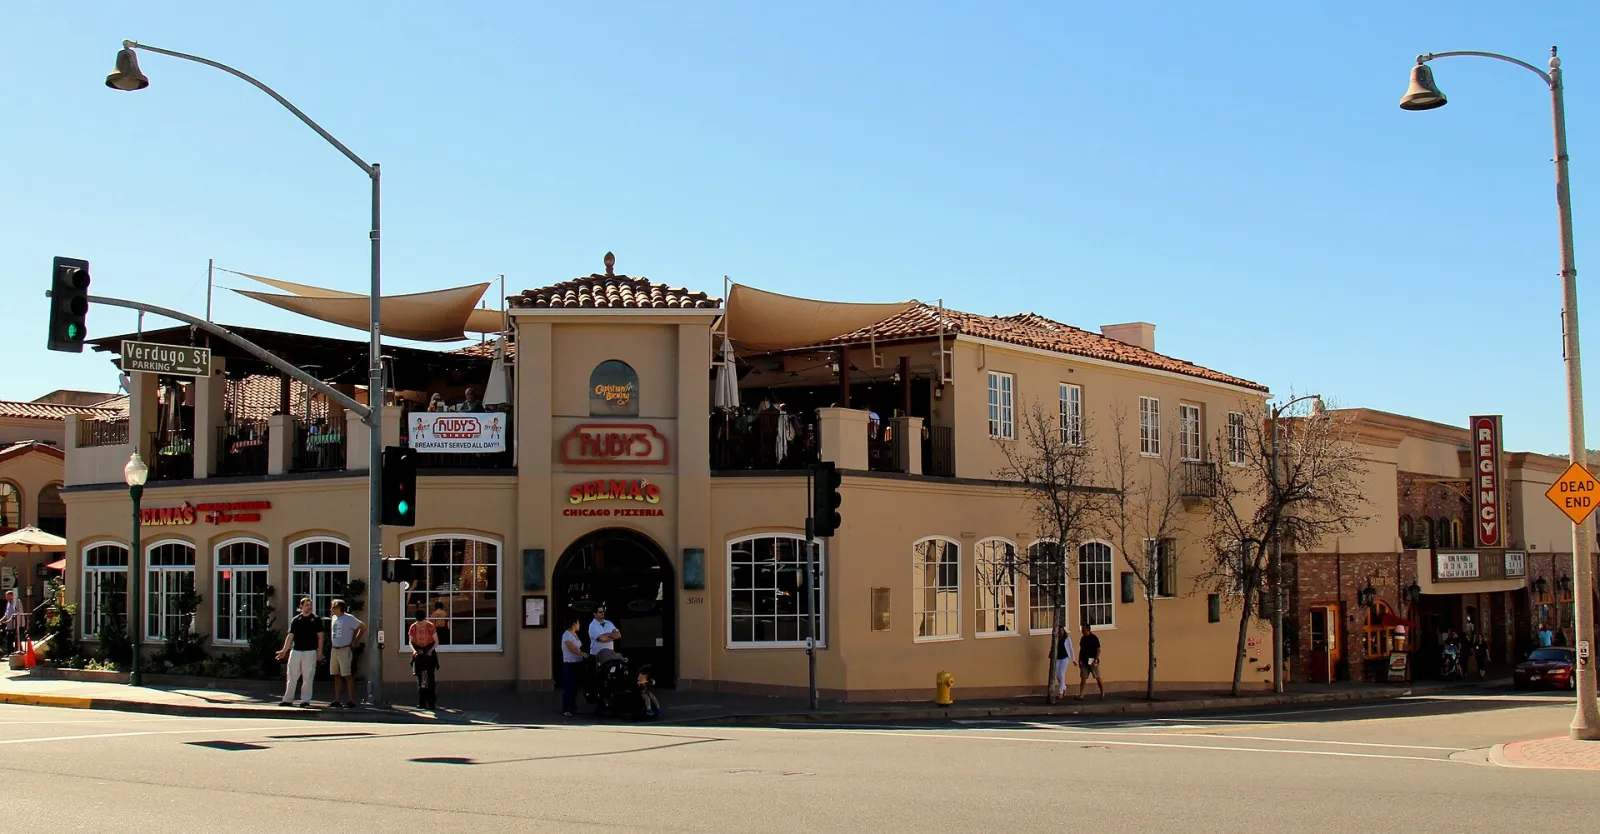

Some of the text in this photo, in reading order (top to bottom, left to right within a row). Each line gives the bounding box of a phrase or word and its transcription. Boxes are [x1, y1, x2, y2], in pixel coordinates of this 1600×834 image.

[127, 343, 207, 366] Verdugo St
[132, 360, 170, 371] PARKING
[438, 420, 476, 431] RUBY'S
[580, 433, 652, 457] RUBY'S
[1479, 428, 1496, 536] REGENCY
[1560, 480, 1595, 493] DEAD
[569, 479, 661, 504] SELMA'S
[1565, 496, 1591, 508] END
[140, 502, 195, 526] ELMA'S
[562, 508, 665, 517] CHICAGO PIZZERIA
